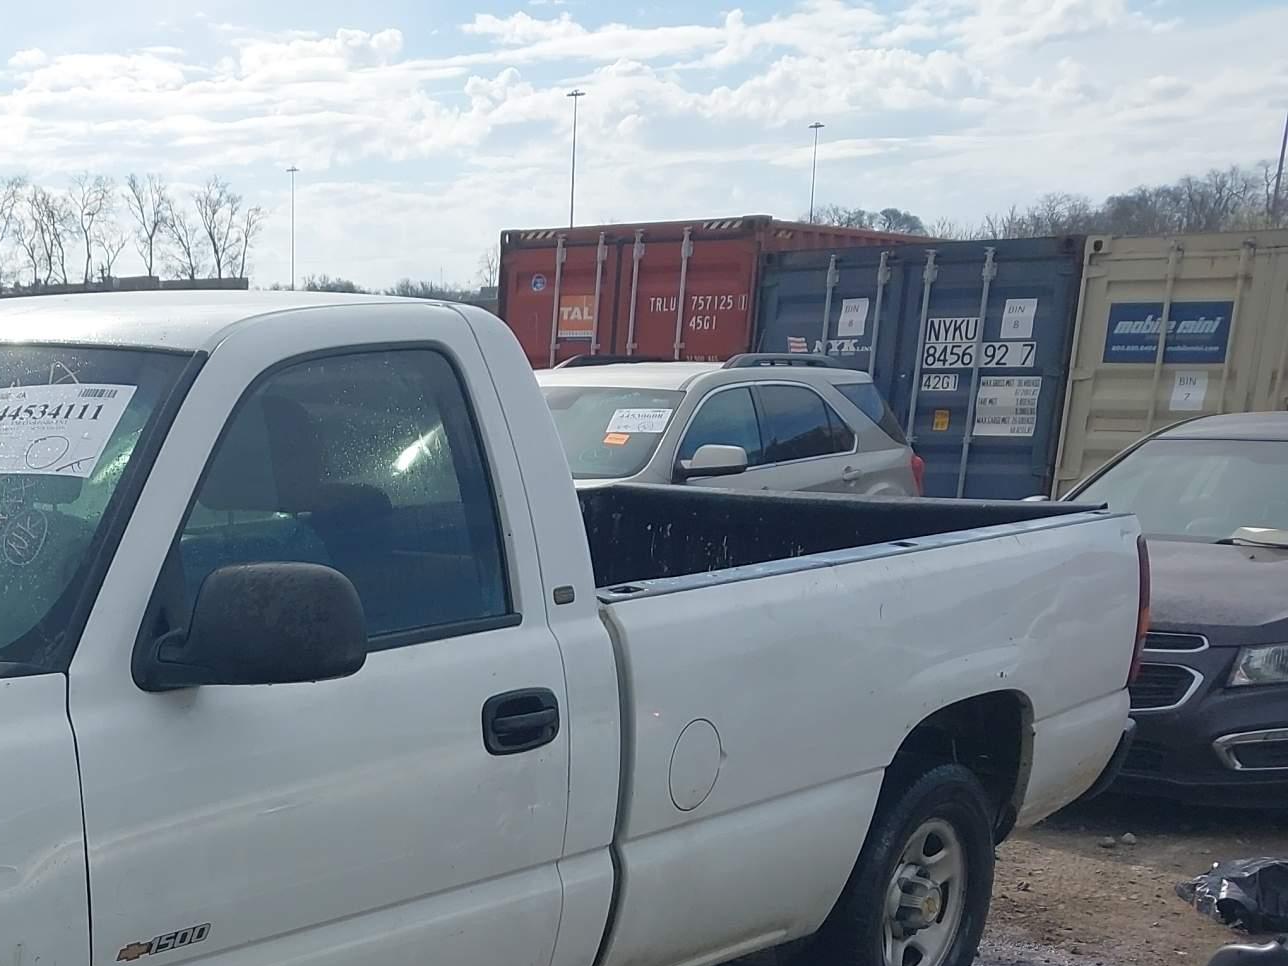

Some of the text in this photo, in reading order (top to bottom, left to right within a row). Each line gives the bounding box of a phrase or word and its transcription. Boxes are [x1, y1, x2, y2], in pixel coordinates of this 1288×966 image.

[650, 297, 677, 312] TRLU
[691, 295, 733, 311] 757125
[1008, 305, 1026, 314] BIN
[560, 307, 593, 320] TAL
[689, 316, 717, 330] 45G1
[927, 319, 979, 342] NYKU
[1113, 314, 1223, 334] mobie mini
[813, 339, 859, 352] NYK
[1021, 343, 1035, 366] 7
[923, 375, 958, 390] 42G1
[1179, 375, 1197, 386] BIN
[148, 922, 212, 956] 1500
